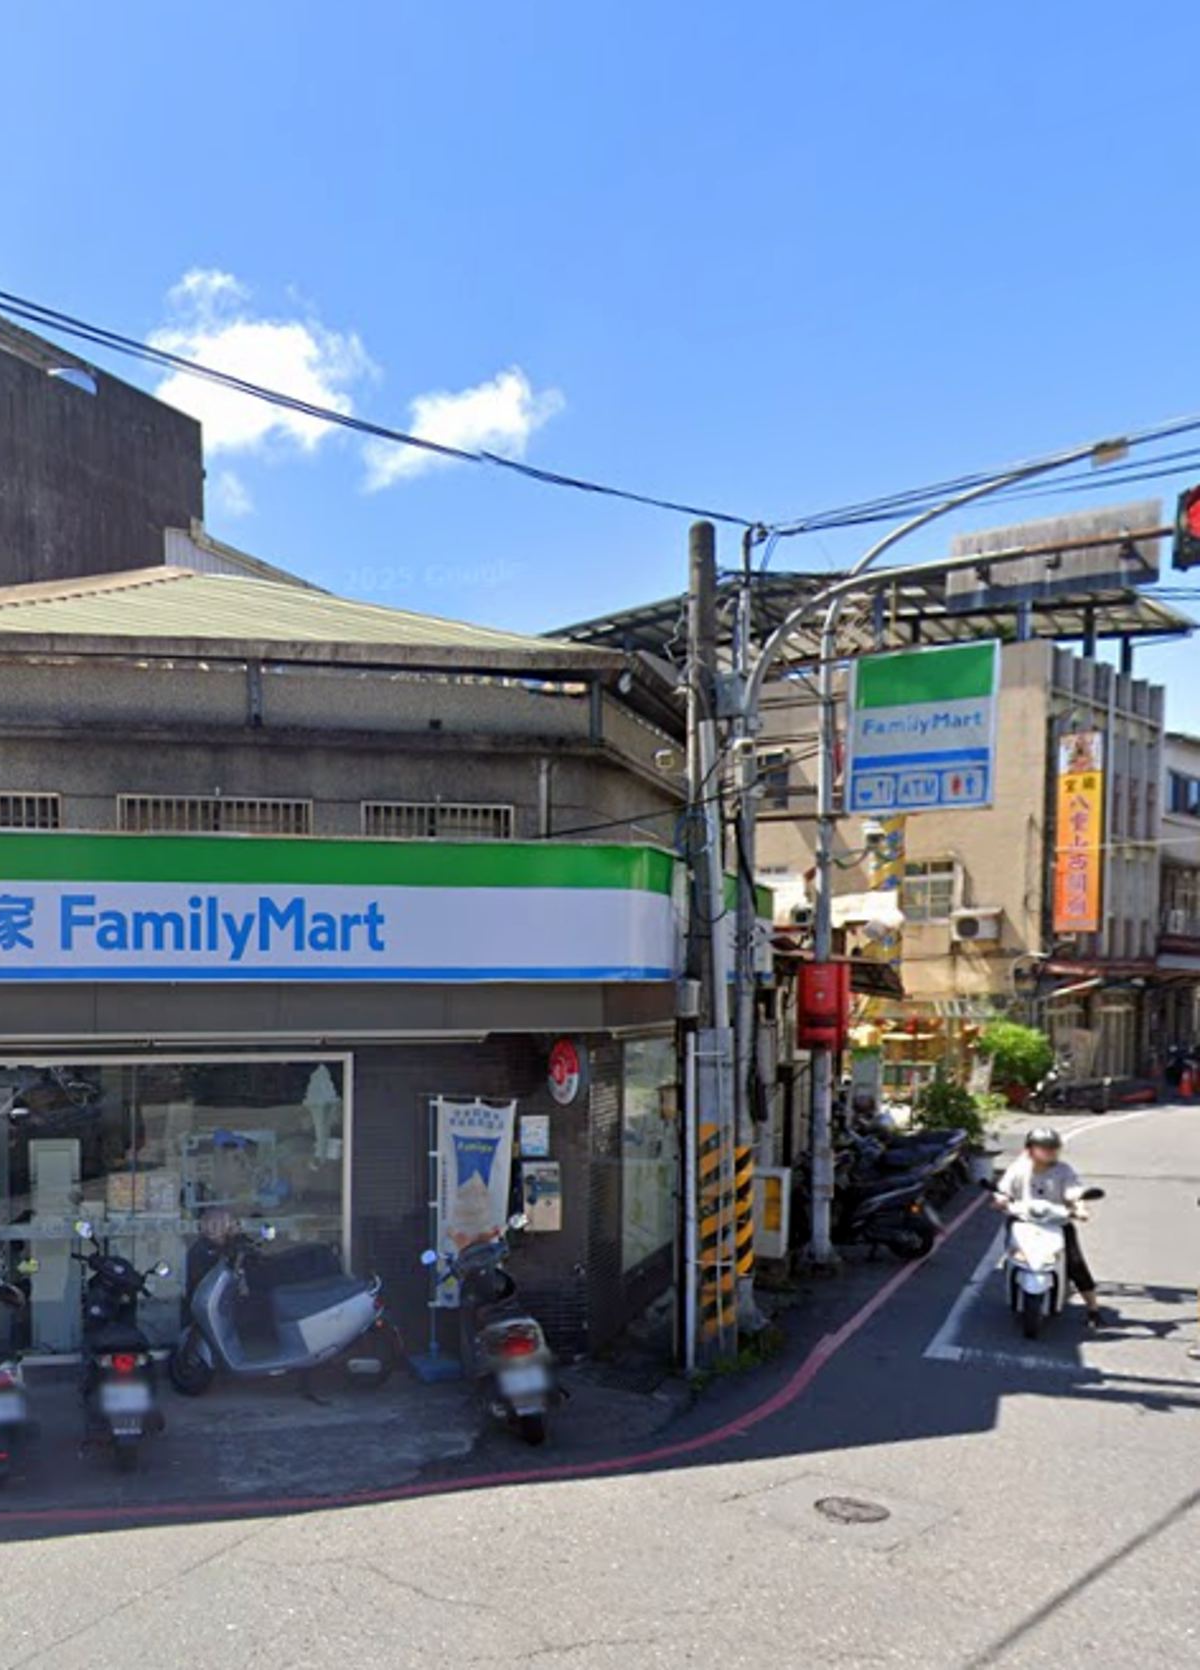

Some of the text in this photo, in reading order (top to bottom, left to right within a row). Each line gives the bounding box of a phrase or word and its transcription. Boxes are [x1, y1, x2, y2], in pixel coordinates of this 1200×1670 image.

[862, 711, 983, 735] FamilyMart
[901, 778, 937, 797] ATM
[61, 895, 386, 960] FamilyMart
